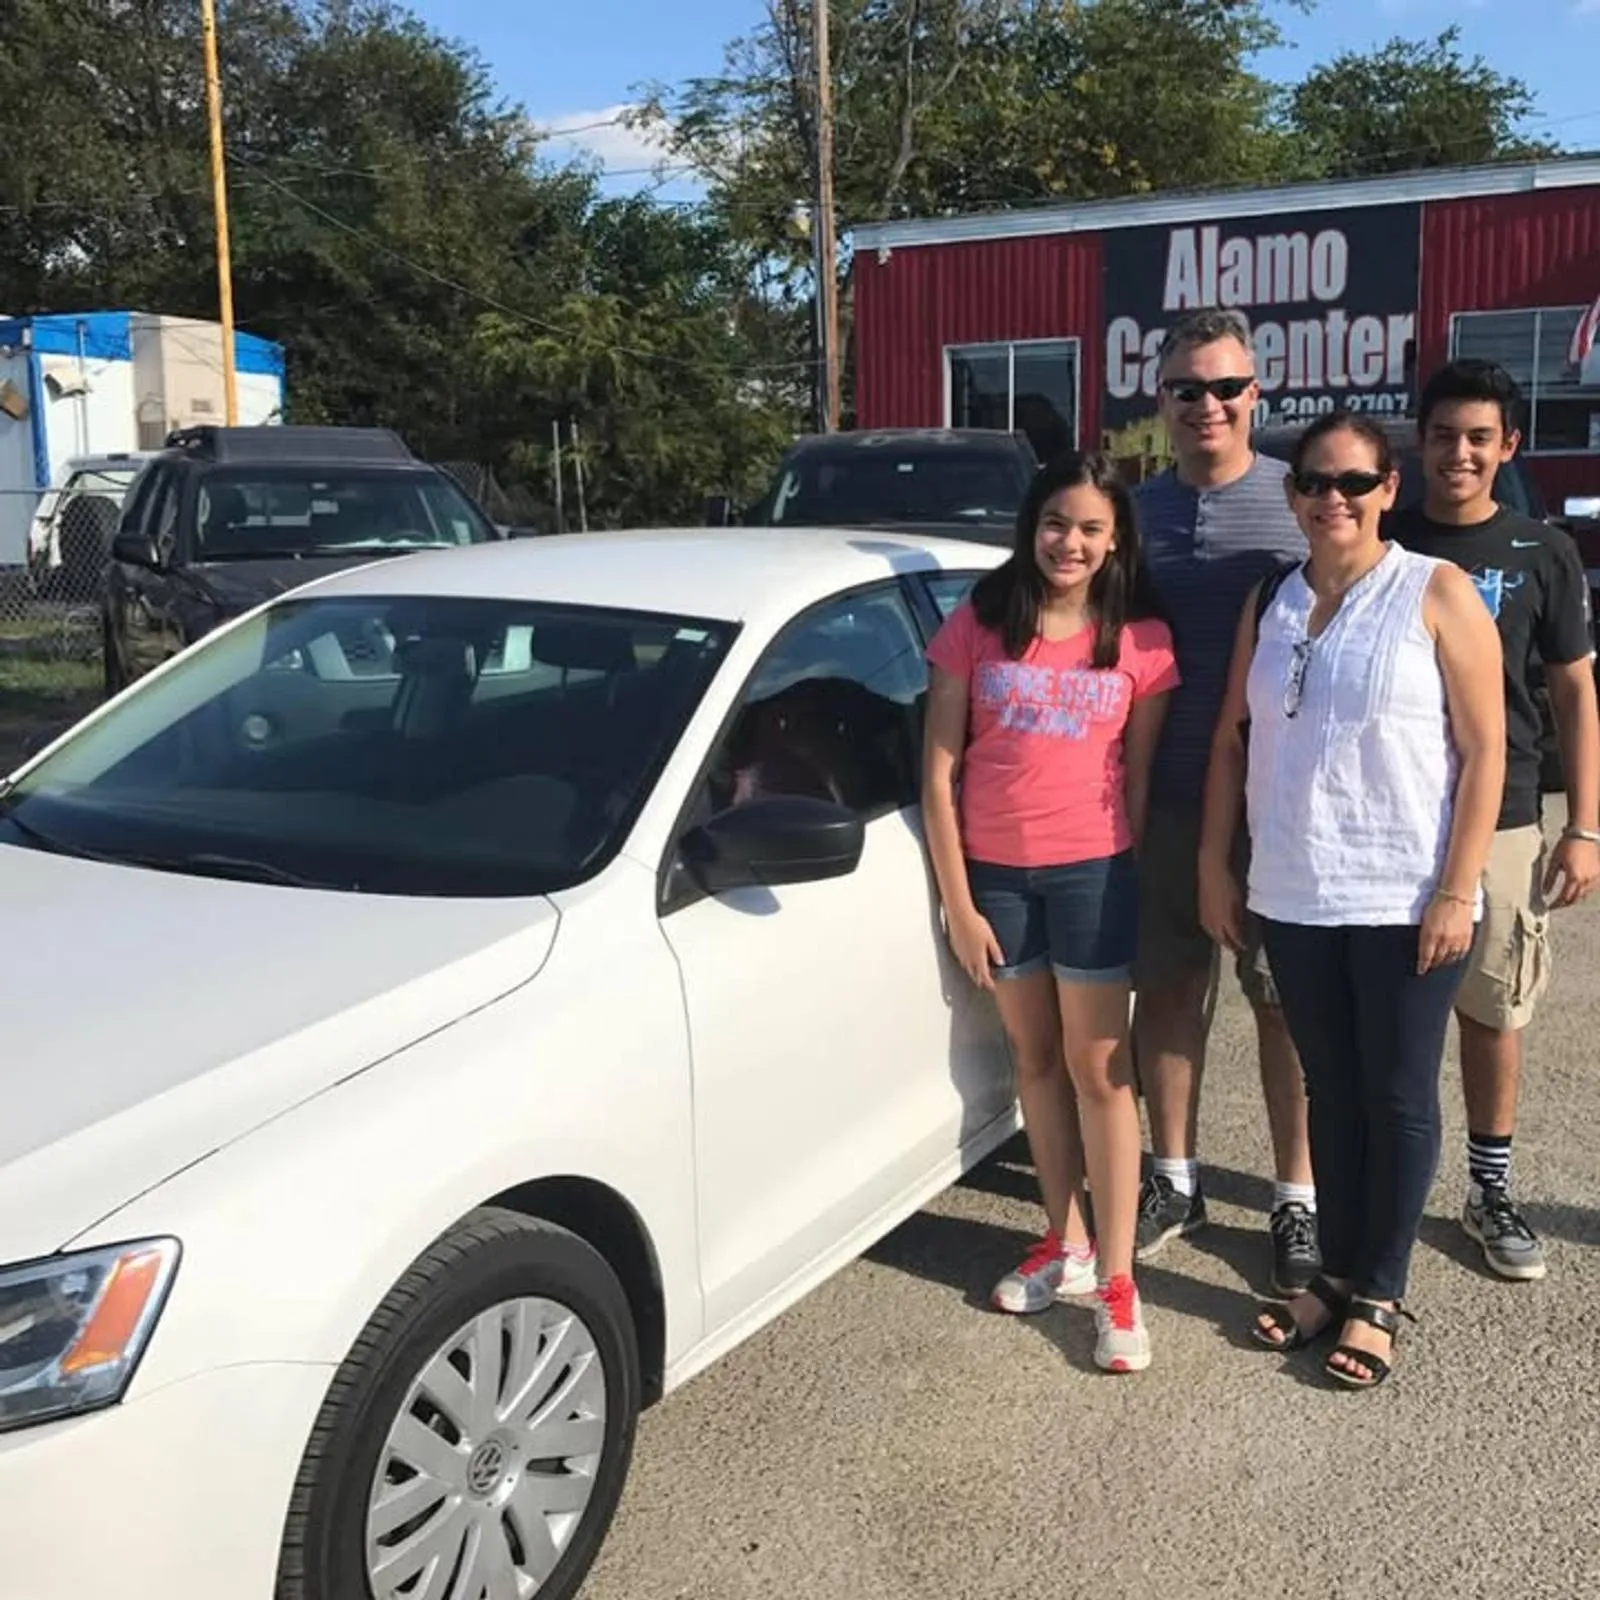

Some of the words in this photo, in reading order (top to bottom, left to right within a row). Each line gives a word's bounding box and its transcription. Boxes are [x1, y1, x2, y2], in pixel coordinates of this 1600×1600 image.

[1163, 226, 1349, 311] Alamo
[1106, 315, 1167, 398] Ca
[1231, 309, 1416, 393] enter
